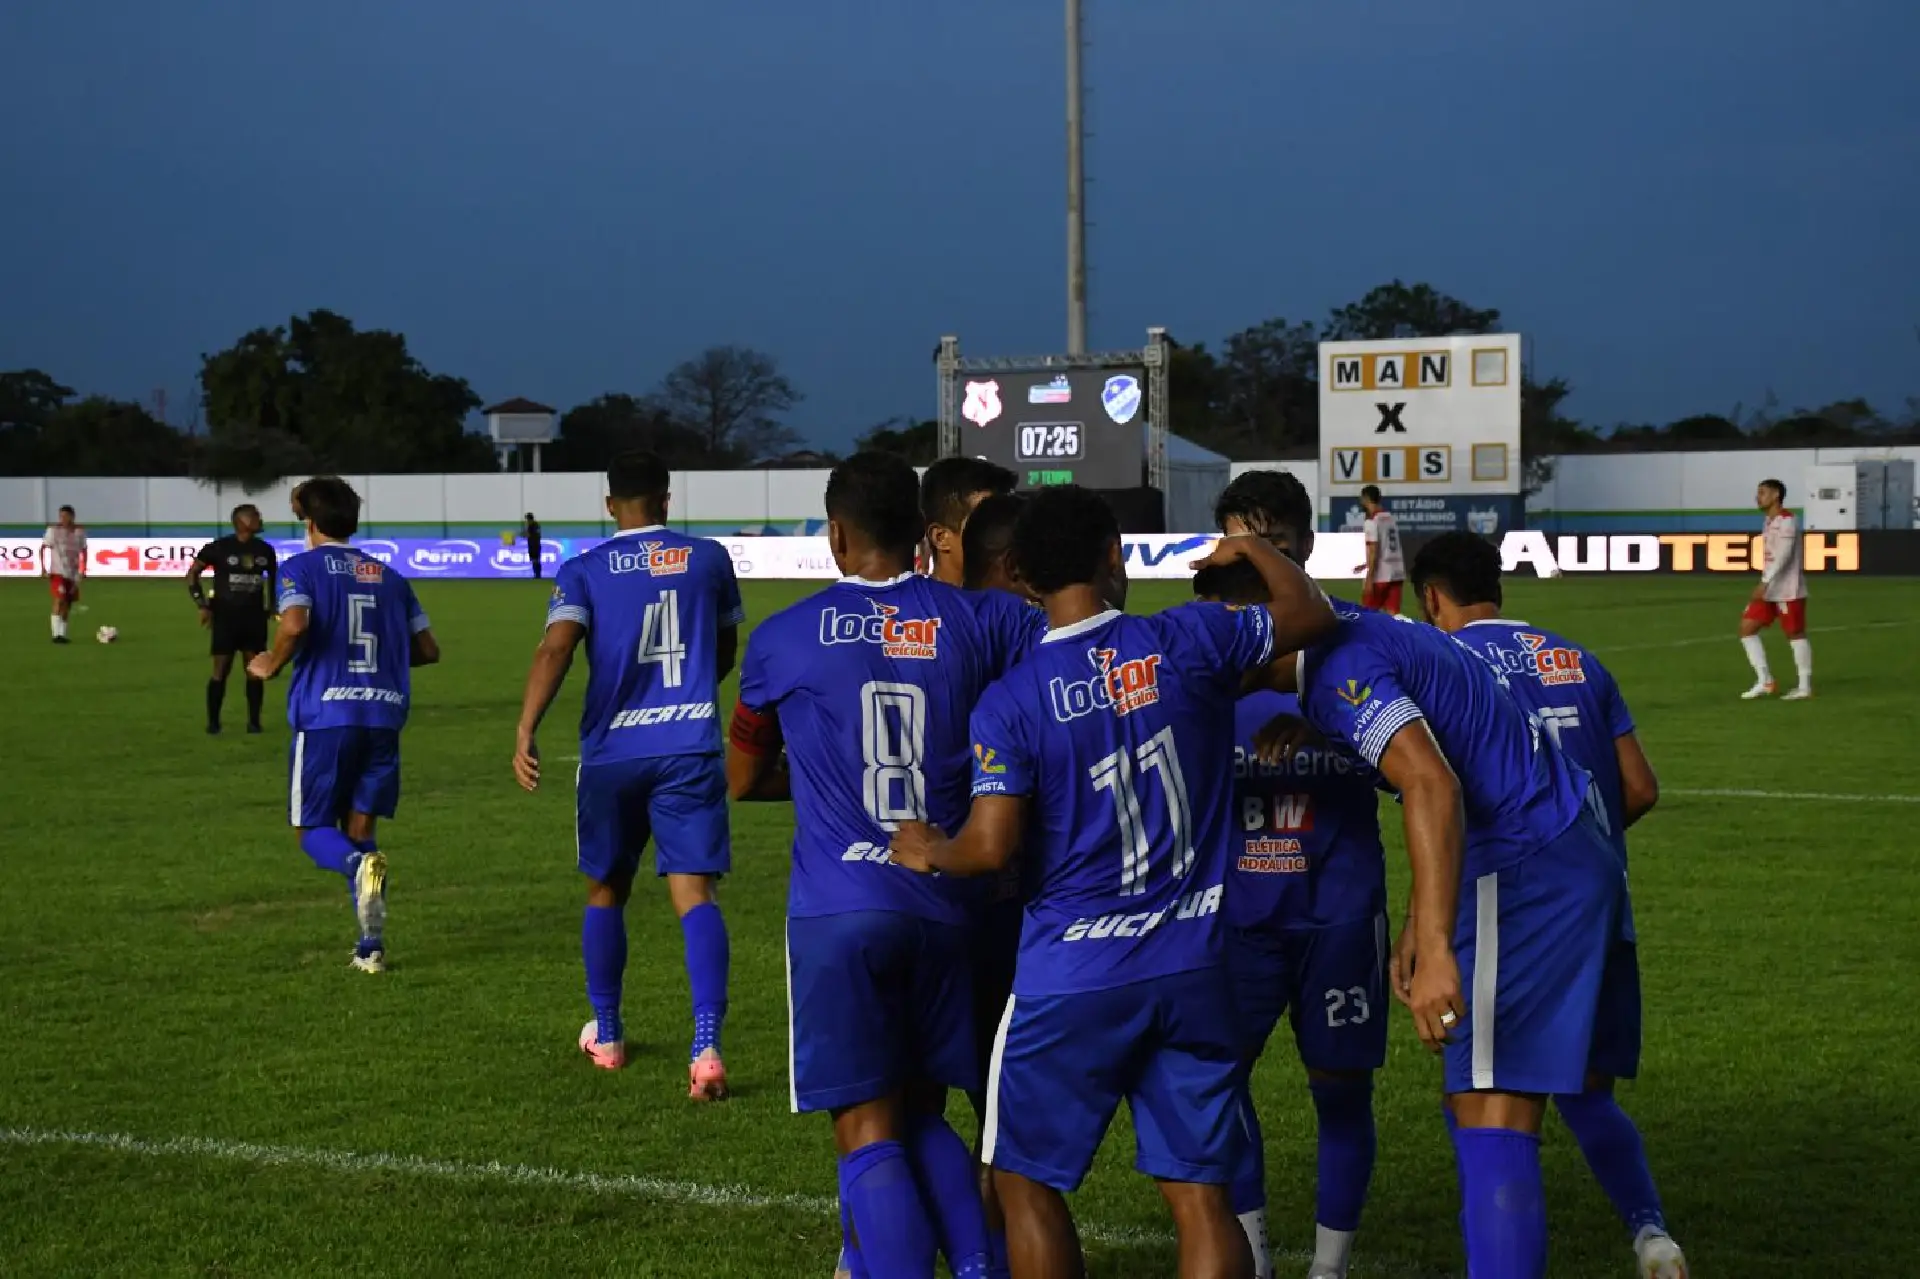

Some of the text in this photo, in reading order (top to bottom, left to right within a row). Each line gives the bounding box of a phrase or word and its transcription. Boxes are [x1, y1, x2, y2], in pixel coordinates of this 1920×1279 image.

[1337, 356, 1446, 383] MAN
[1375, 402, 1407, 433] X
[1021, 427, 1078, 456] 07:25
[1337, 451, 1443, 479] VIS
[144, 545, 198, 561] GIR
[347, 594, 378, 672] 5
[637, 589, 685, 688] 4
[820, 606, 942, 645] loccar
[860, 680, 929, 832] 8
[1089, 725, 1195, 896] 11
[1325, 985, 1370, 1027] 23
